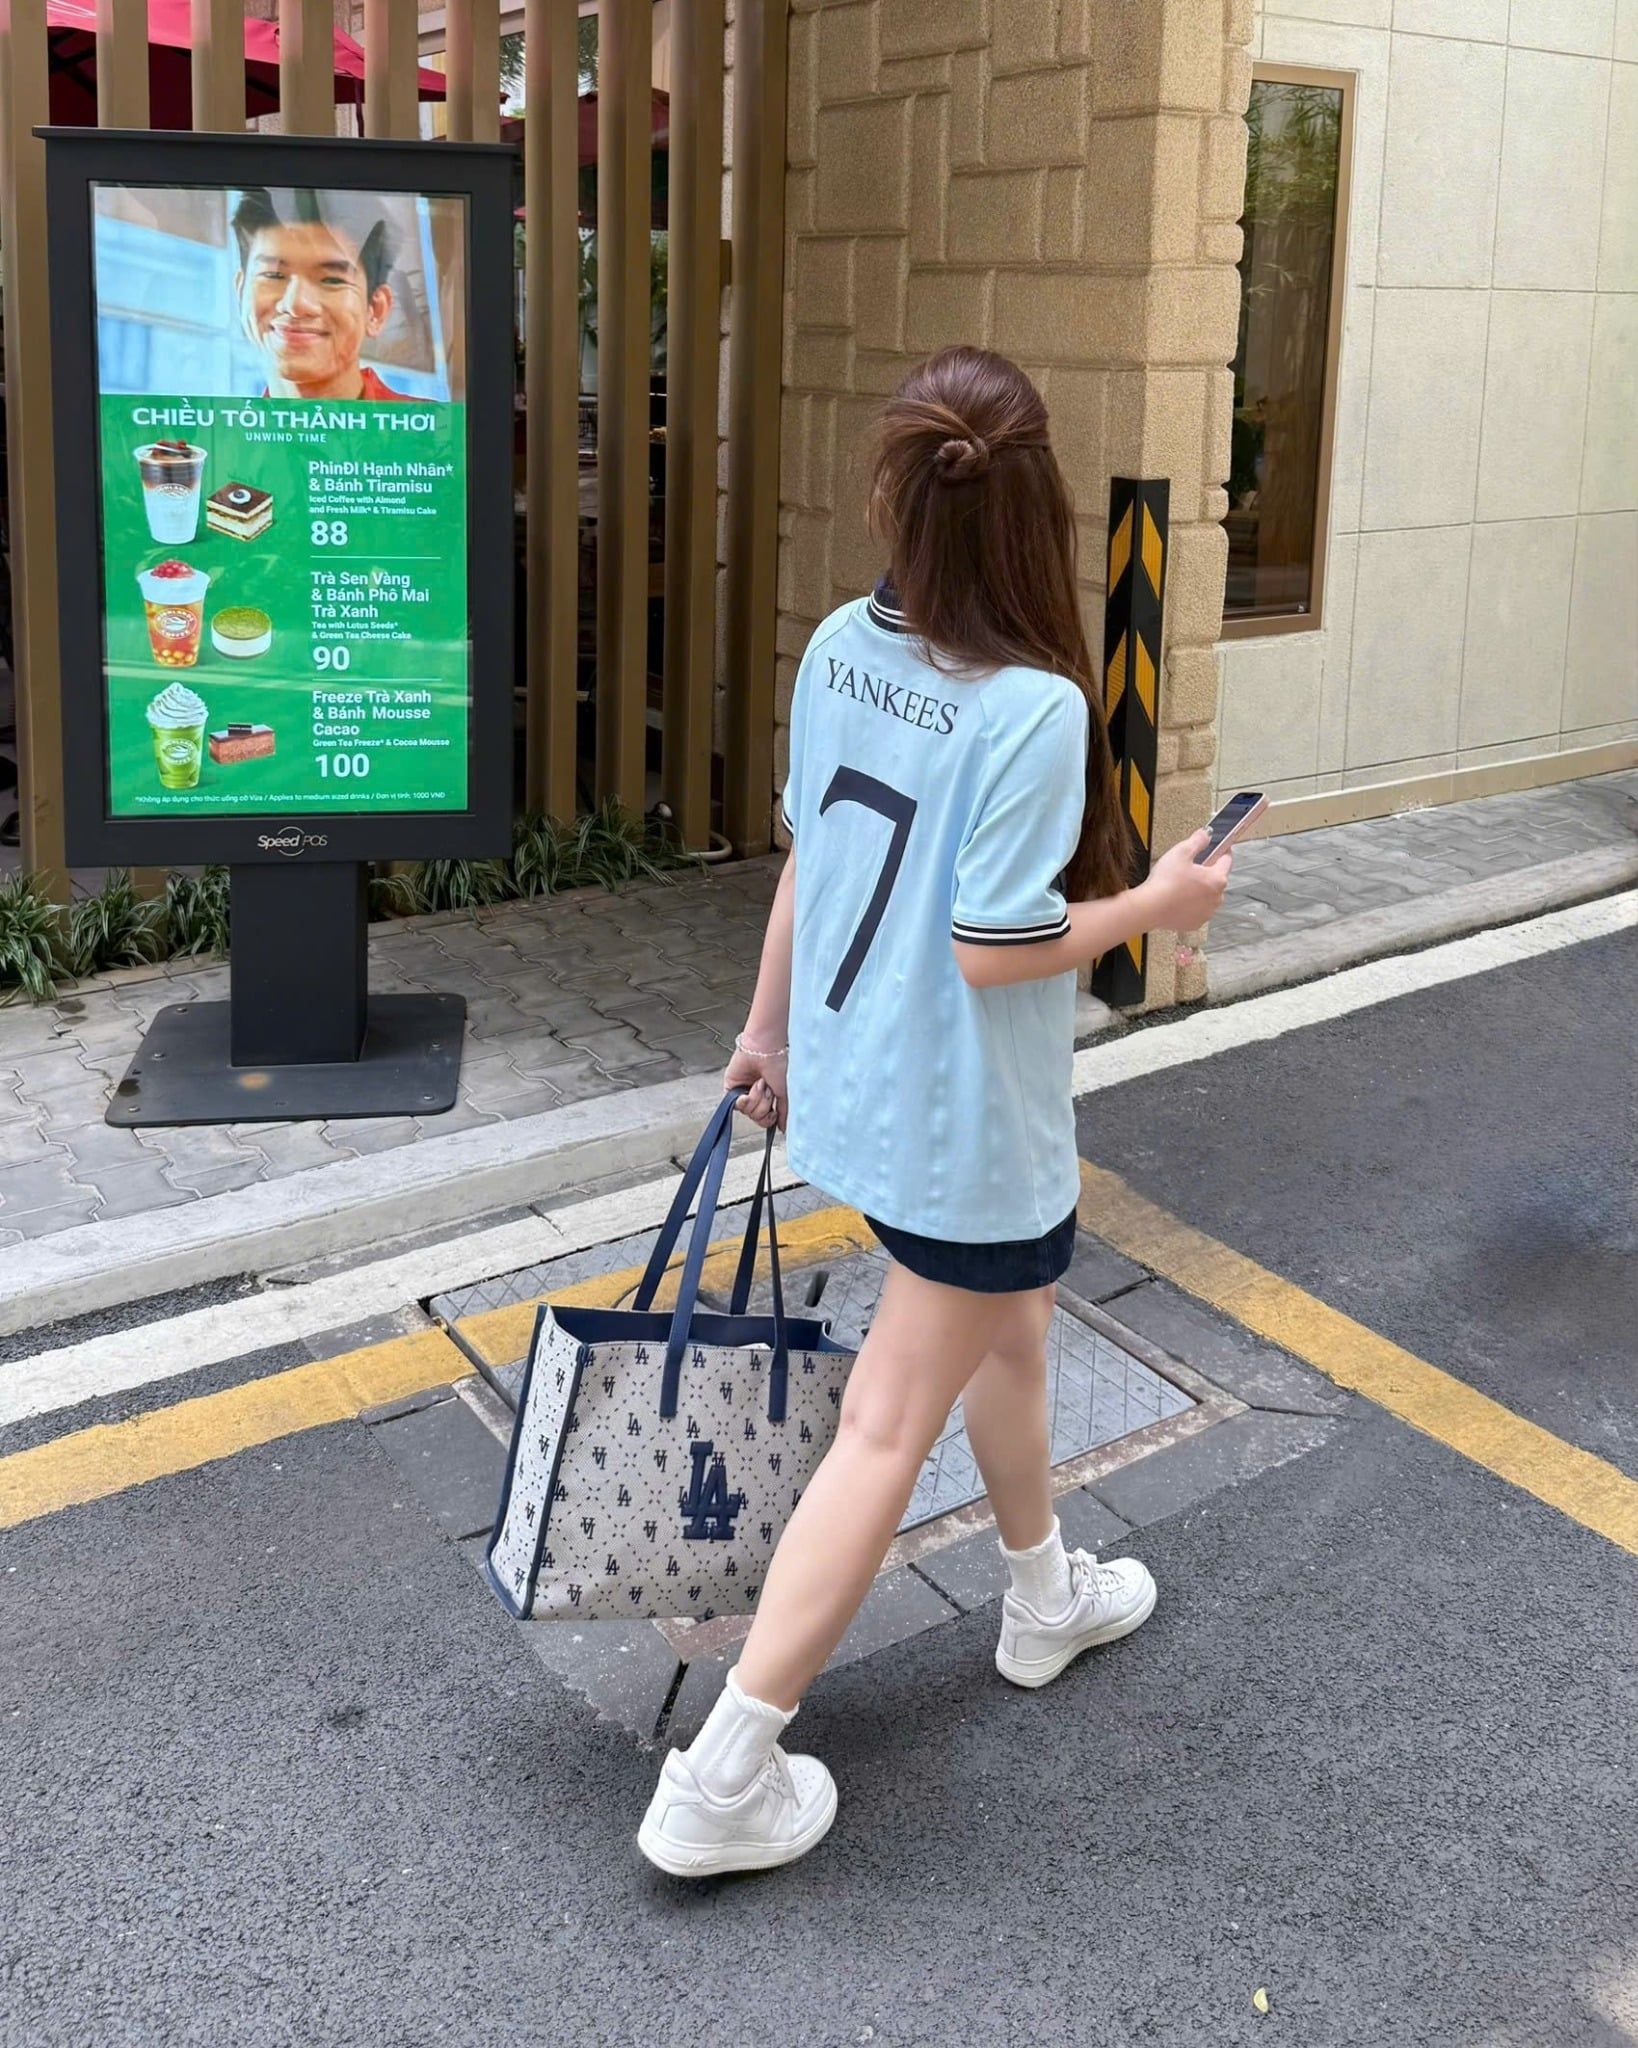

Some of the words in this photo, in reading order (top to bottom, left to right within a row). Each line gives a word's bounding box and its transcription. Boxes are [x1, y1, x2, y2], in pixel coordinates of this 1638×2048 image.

[132, 397, 214, 427] CHIỀU
[220, 400, 265, 428] TỐI
[271, 405, 367, 430] THẢNH
[373, 412, 436, 432] THƠI
[245, 432, 293, 442] UNWIND
[298, 433, 327, 443] TIME
[363, 462, 403, 478] Hạnh
[309, 478, 321, 492] &
[325, 478, 363, 492] Bánh
[366, 479, 433, 493] Tiramisu
[309, 495, 327, 504] Iced
[328, 495, 355, 504] Coffee
[356, 496, 374, 504] with
[375, 496, 407, 505] Almond
[309, 506, 325, 514] and
[326, 506, 349, 514] Fresh
[373, 506, 380, 514] &
[381, 506, 415, 515] Tiramisu
[416, 507, 437, 515] Cake
[311, 520, 348, 546] 88
[310, 571, 336, 585] Trà
[340, 571, 368, 585] Sen
[372, 571, 410, 588] Vàng
[311, 588, 322, 602] &
[326, 587, 365, 602] Bánh
[368, 587, 398, 602] Phô
[402, 588, 430, 602] Mai
[311, 604, 336, 618] Trà
[340, 604, 379, 618] Xanh
[312, 621, 327, 629] Tea
[328, 621, 345, 629] with
[346, 621, 369, 630] Lotus
[319, 632, 344, 640] Green
[345, 632, 360, 640] Tea
[360, 632, 390, 640] Cheese
[391, 632, 412, 640] Cake
[313, 646, 350, 671] 90
[312, 690, 363, 703] Freeze
[365, 689, 391, 703] Trà
[394, 689, 432, 703] Xanh
[826, 656, 959, 735] YANKEES
[313, 706, 324, 720] &
[328, 706, 366, 720] Bánh
[372, 706, 431, 719] Mousse
[312, 722, 360, 736] Cacao
[312, 739, 337, 747] Green
[337, 739, 353, 747] Tea
[386, 738, 392, 746] &
[393, 738, 418, 746] Cocoa
[419, 738, 450, 746] Mousse
[315, 753, 370, 778] 100
[257, 834, 300, 850] Speed
[302, 834, 328, 846] POS
[819, 765, 917, 1012] 7
[635, 1343, 649, 1365] LA
[692, 1346, 707, 1368] LA
[750, 1350, 762, 1371] LA
[802, 1352, 816, 1374] LA
[602, 1376, 616, 1398] LA
[720, 1382, 733, 1405] LA
[828, 1387, 841, 1409] LA
[627, 1413, 642, 1436] LA
[686, 1415, 701, 1438] LA
[744, 1418, 757, 1441] LA
[800, 1420, 813, 1443] LA
[592, 1446, 607, 1470] LA
[654, 1449, 667, 1473] LA
[768, 1453, 782, 1476] LA
[617, 1484, 632, 1507] LA
[681, 1440, 741, 1540] LA
[580, 1516, 596, 1540] LA
[643, 1520, 658, 1543] LA
[760, 1522, 773, 1544] LA
[605, 1554, 620, 1575] LA
[666, 1555, 681, 1577] LA
[725, 1556, 738, 1577] LA
[567, 1583, 583, 1607] LA
[628, 1586, 643, 1604] LA
